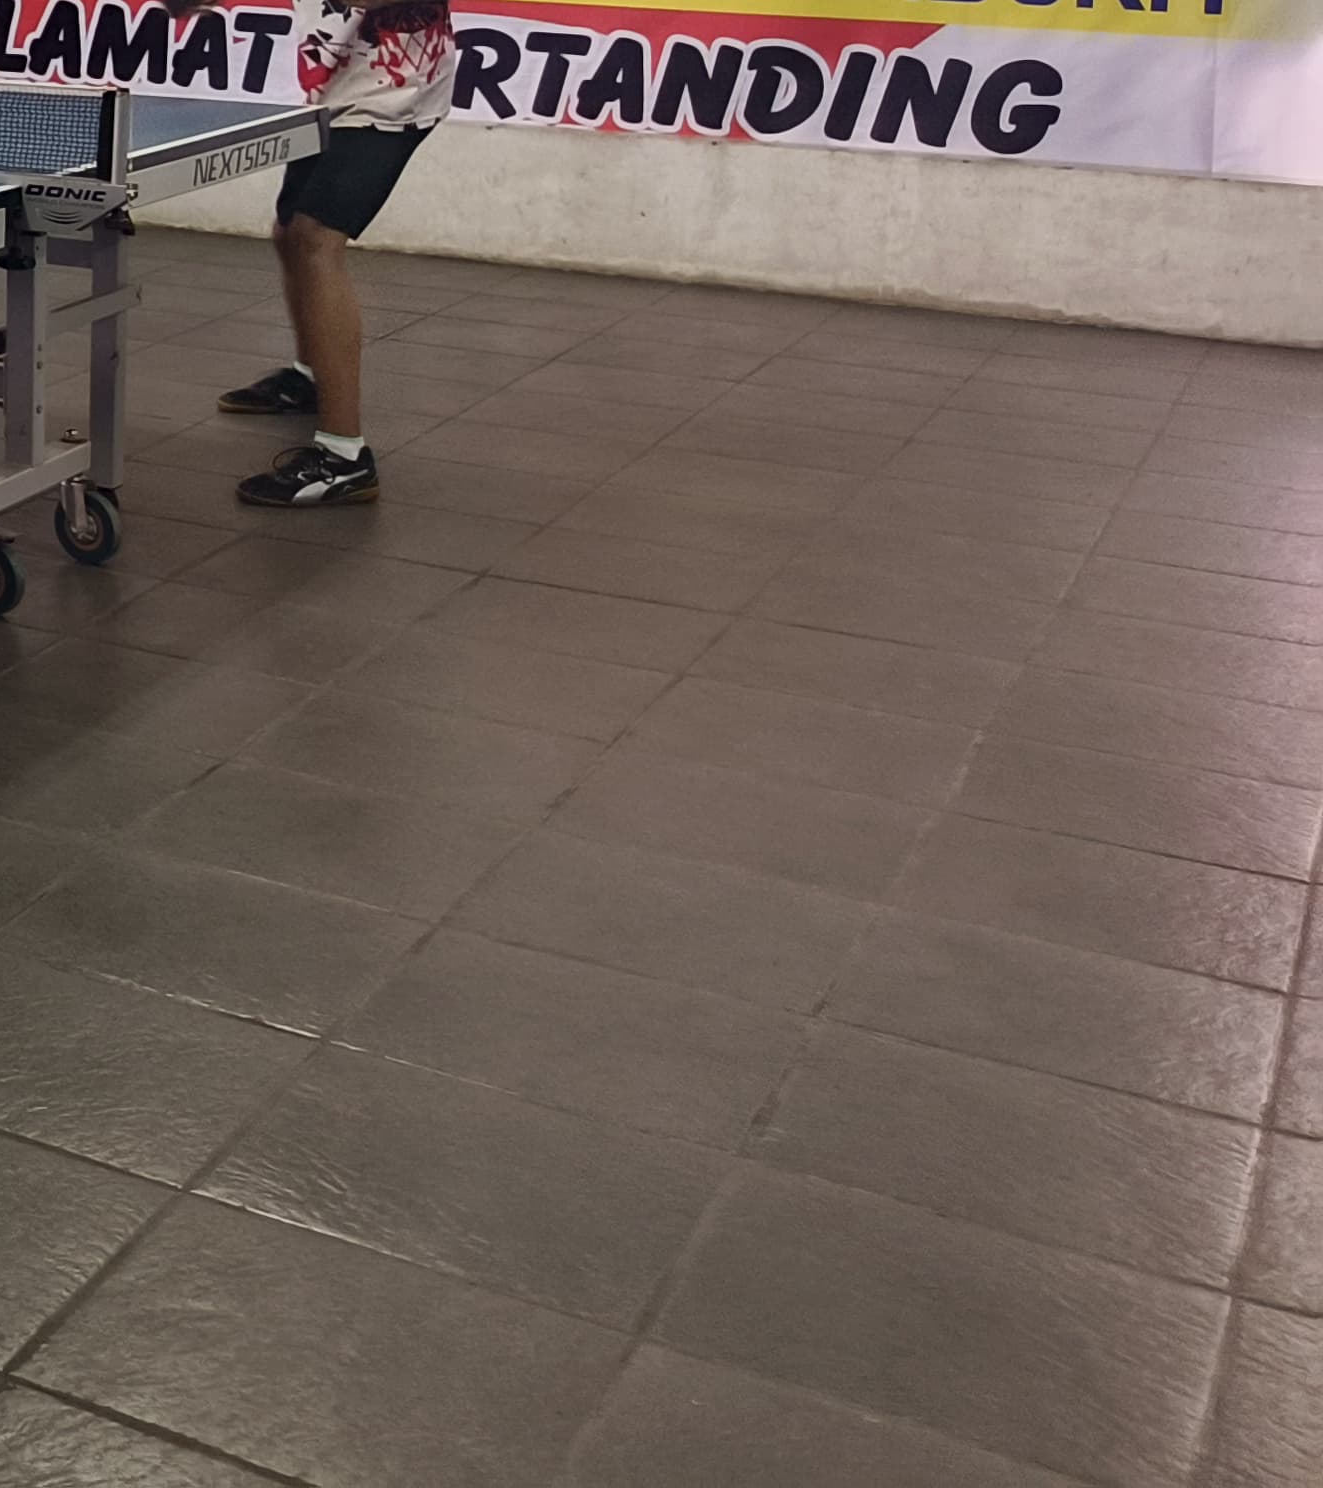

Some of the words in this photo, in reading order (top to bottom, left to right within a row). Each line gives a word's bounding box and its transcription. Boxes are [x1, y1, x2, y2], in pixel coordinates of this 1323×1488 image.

[451, 27, 1064, 155] RTANDING
[193, 135, 282, 188] NEXTSIST
[24, 183, 107, 203] DONIC
